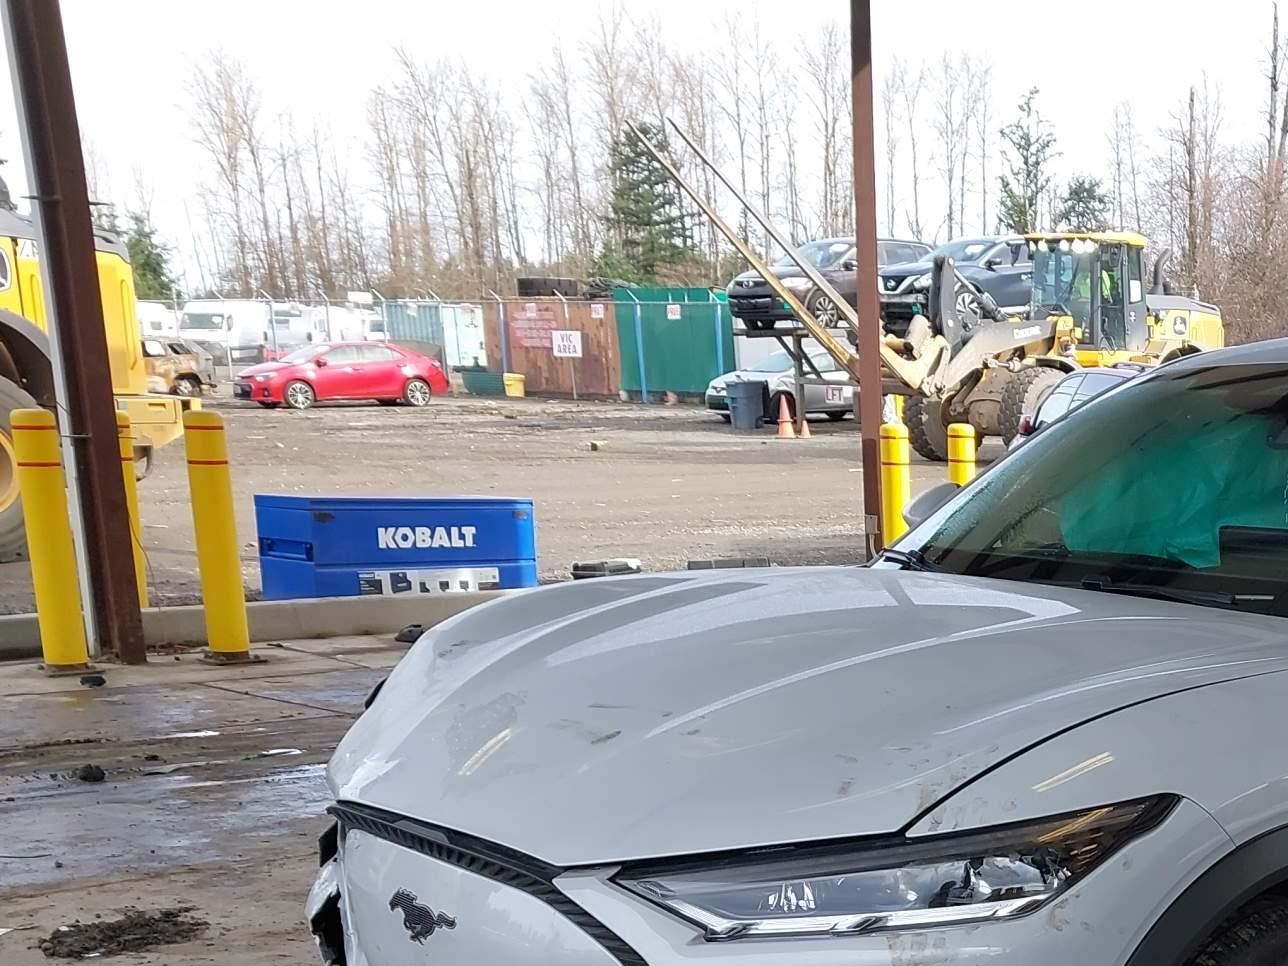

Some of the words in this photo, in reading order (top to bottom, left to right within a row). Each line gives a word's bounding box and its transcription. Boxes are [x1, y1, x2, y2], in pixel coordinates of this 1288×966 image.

[560, 333, 573, 343] VIC
[557, 344, 578, 354] AREA
[377, 526, 477, 549] KOBALT
